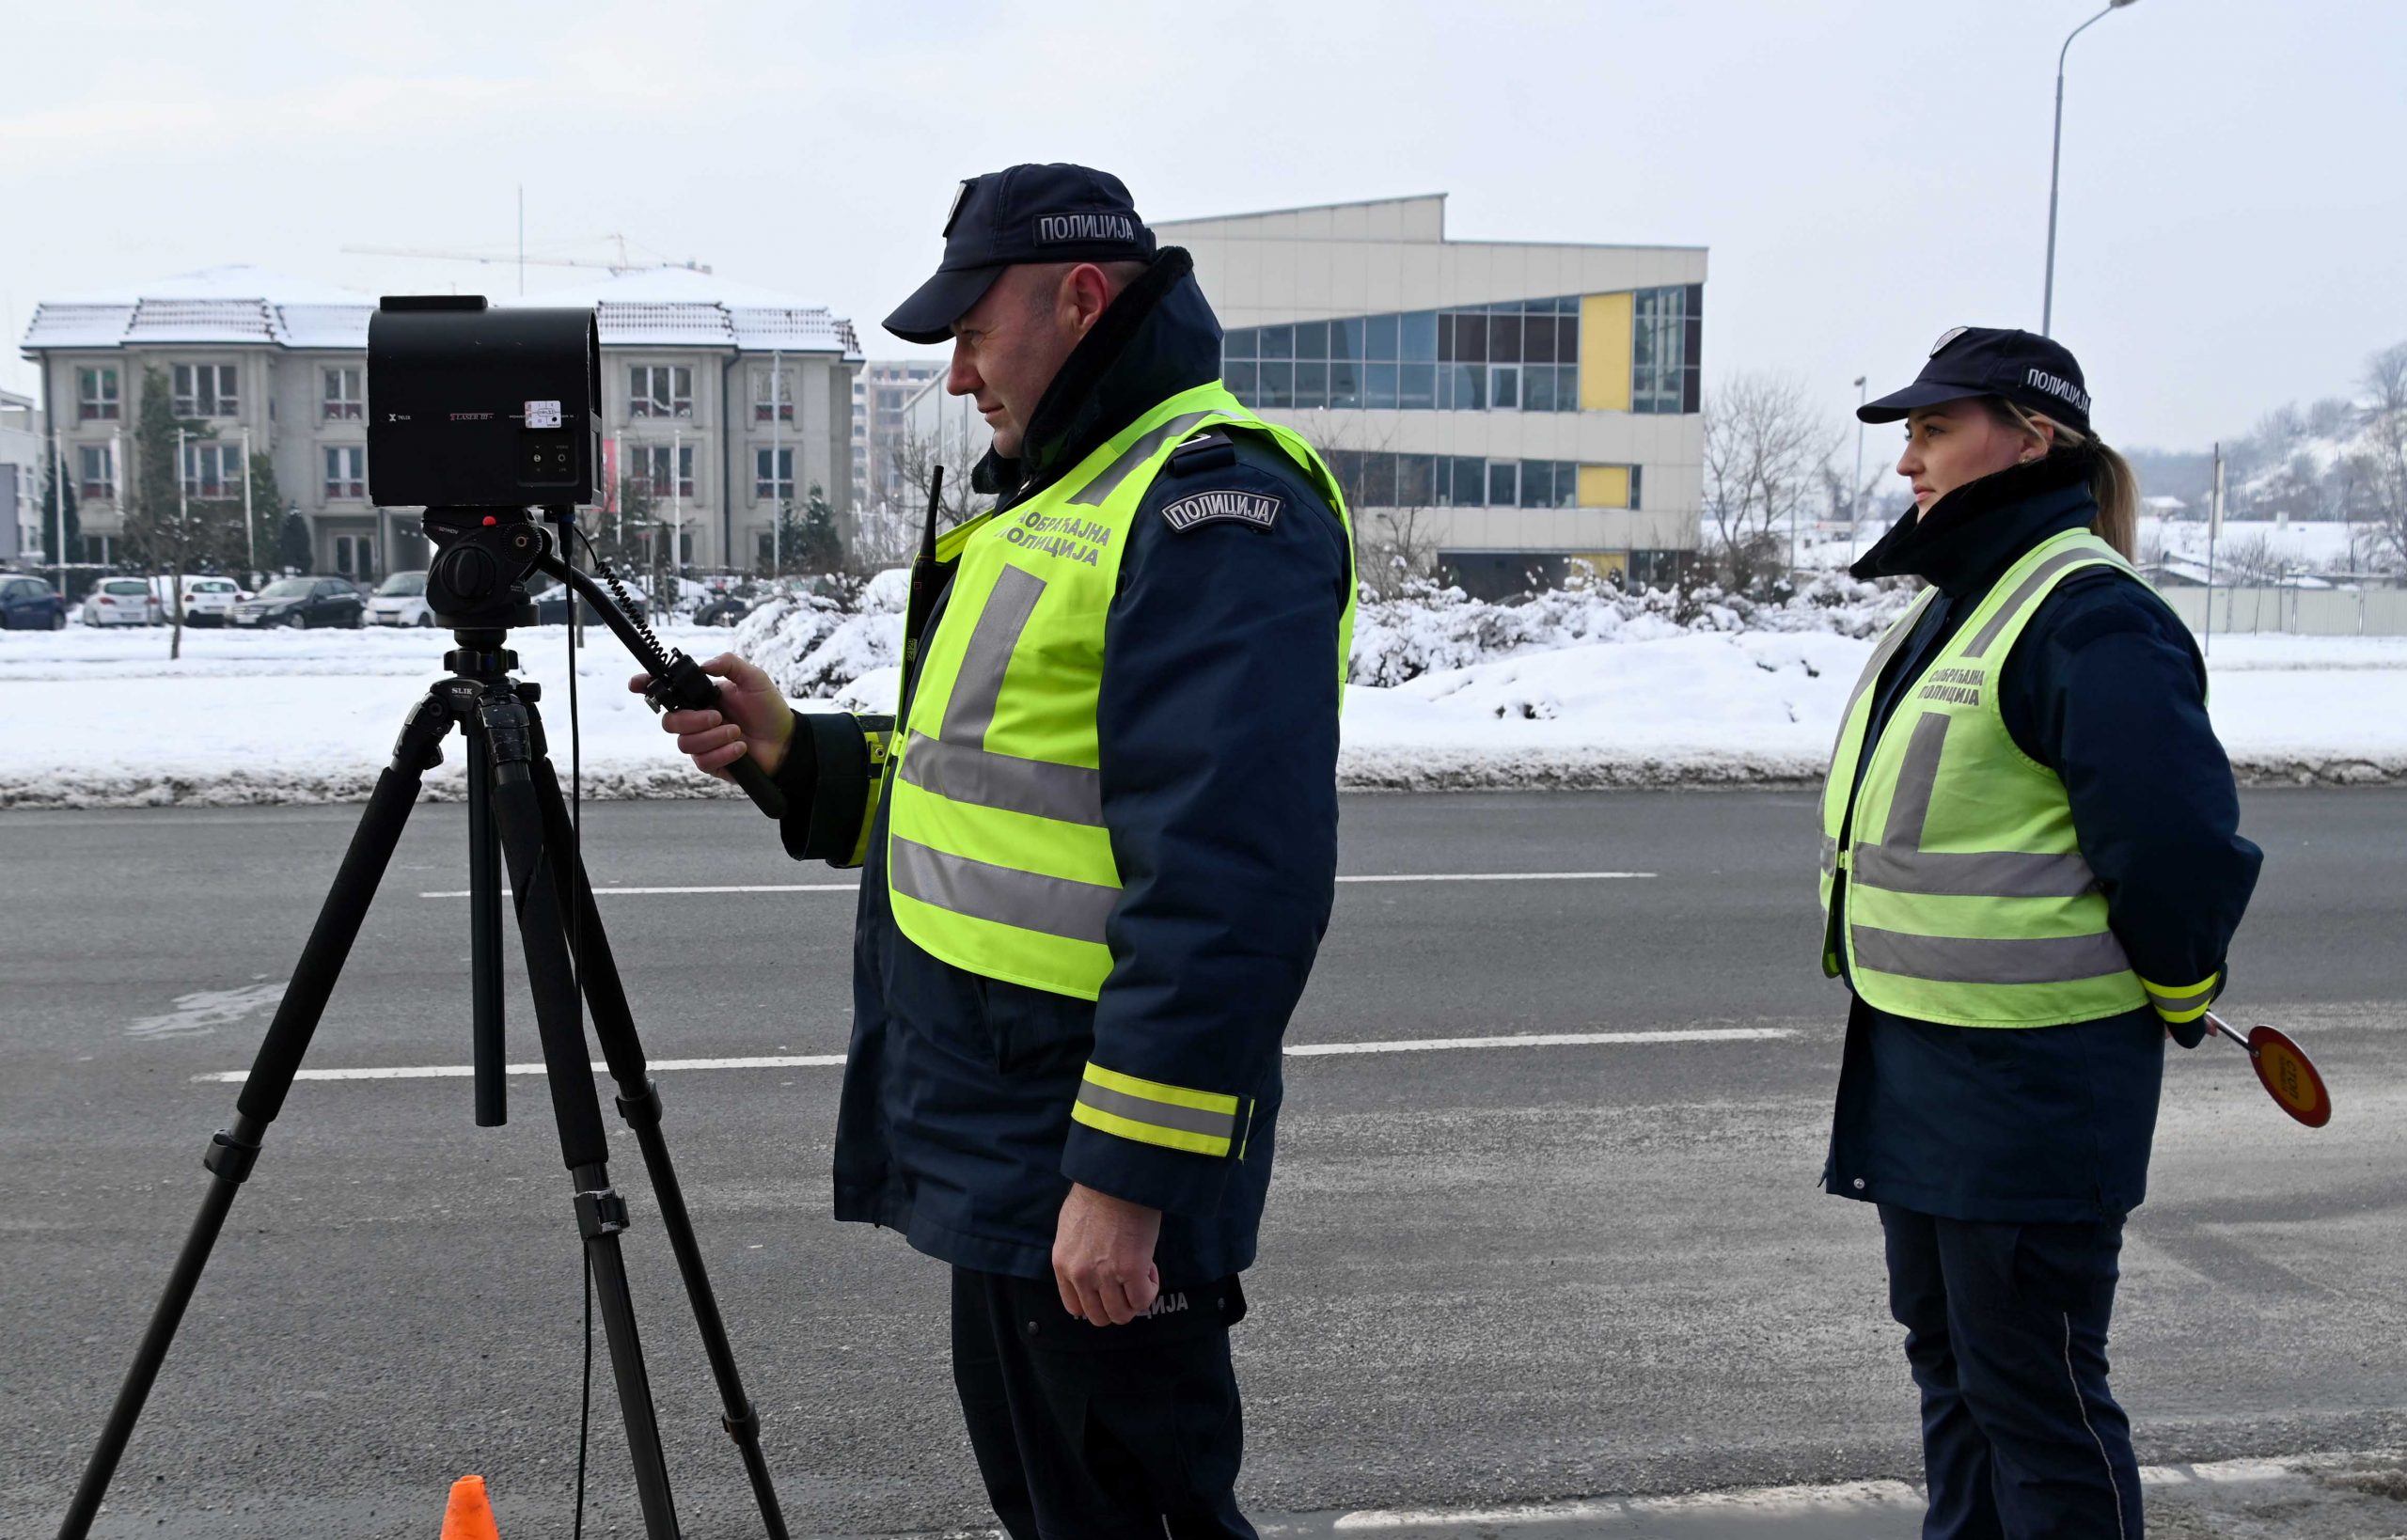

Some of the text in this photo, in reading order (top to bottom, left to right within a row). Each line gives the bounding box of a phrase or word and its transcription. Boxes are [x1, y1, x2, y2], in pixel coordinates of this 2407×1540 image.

[1040, 214, 1135, 241] ПОЛИЦИЈА
[2027, 369, 2088, 415] ПОЛИЦИЈА
[1169, 494, 1269, 526] ПОЛИЦИЈА
[1015, 511, 1111, 547] АОБРАЋАЈНА
